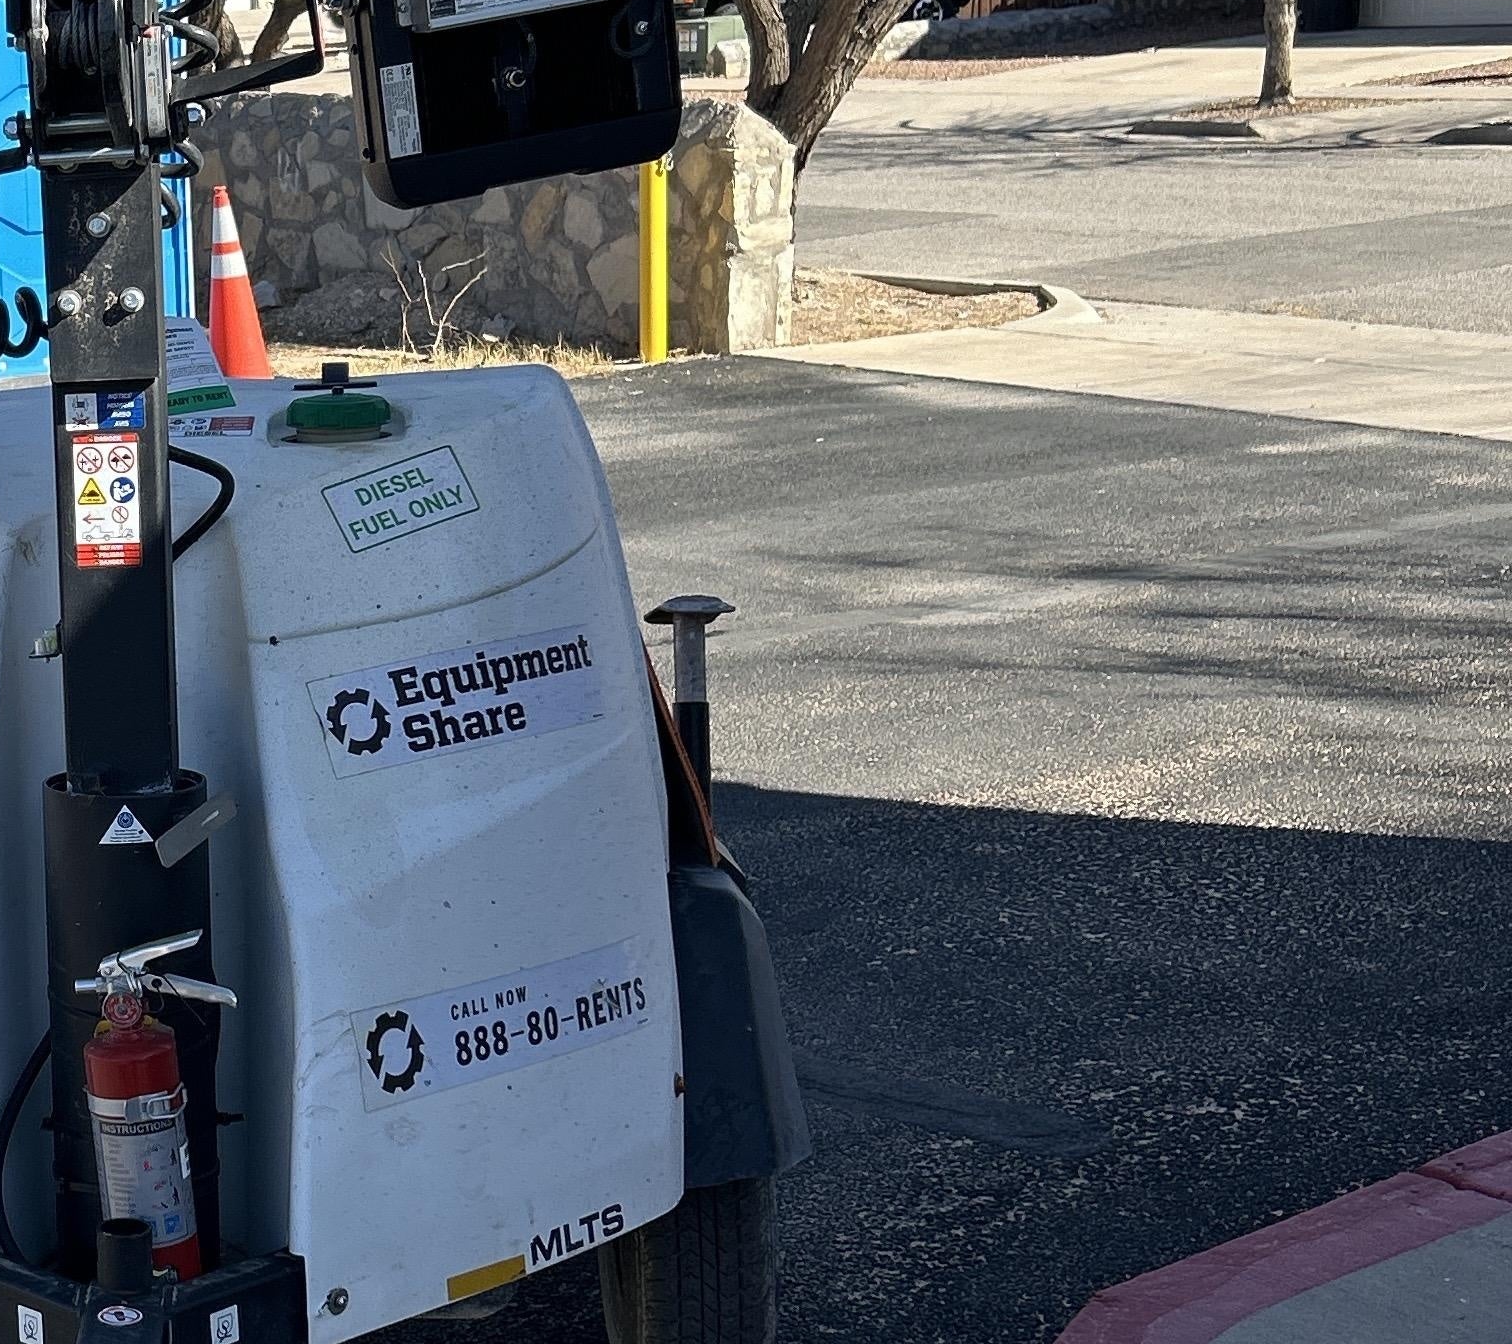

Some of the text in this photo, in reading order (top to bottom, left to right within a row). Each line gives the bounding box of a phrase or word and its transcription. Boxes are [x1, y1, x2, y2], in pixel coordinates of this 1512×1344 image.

[167, 391, 228, 408] EADY TO RENT
[348, 484, 463, 540] FUEL ONLY
[354, 467, 434, 506] DIESEL
[387, 634, 593, 708] Equipment
[402, 702, 528, 753] Share
[450, 984, 528, 1021] CALL NOW
[455, 976, 647, 1067] 888-80-RENTS
[529, 1202, 625, 1266] MLTS
